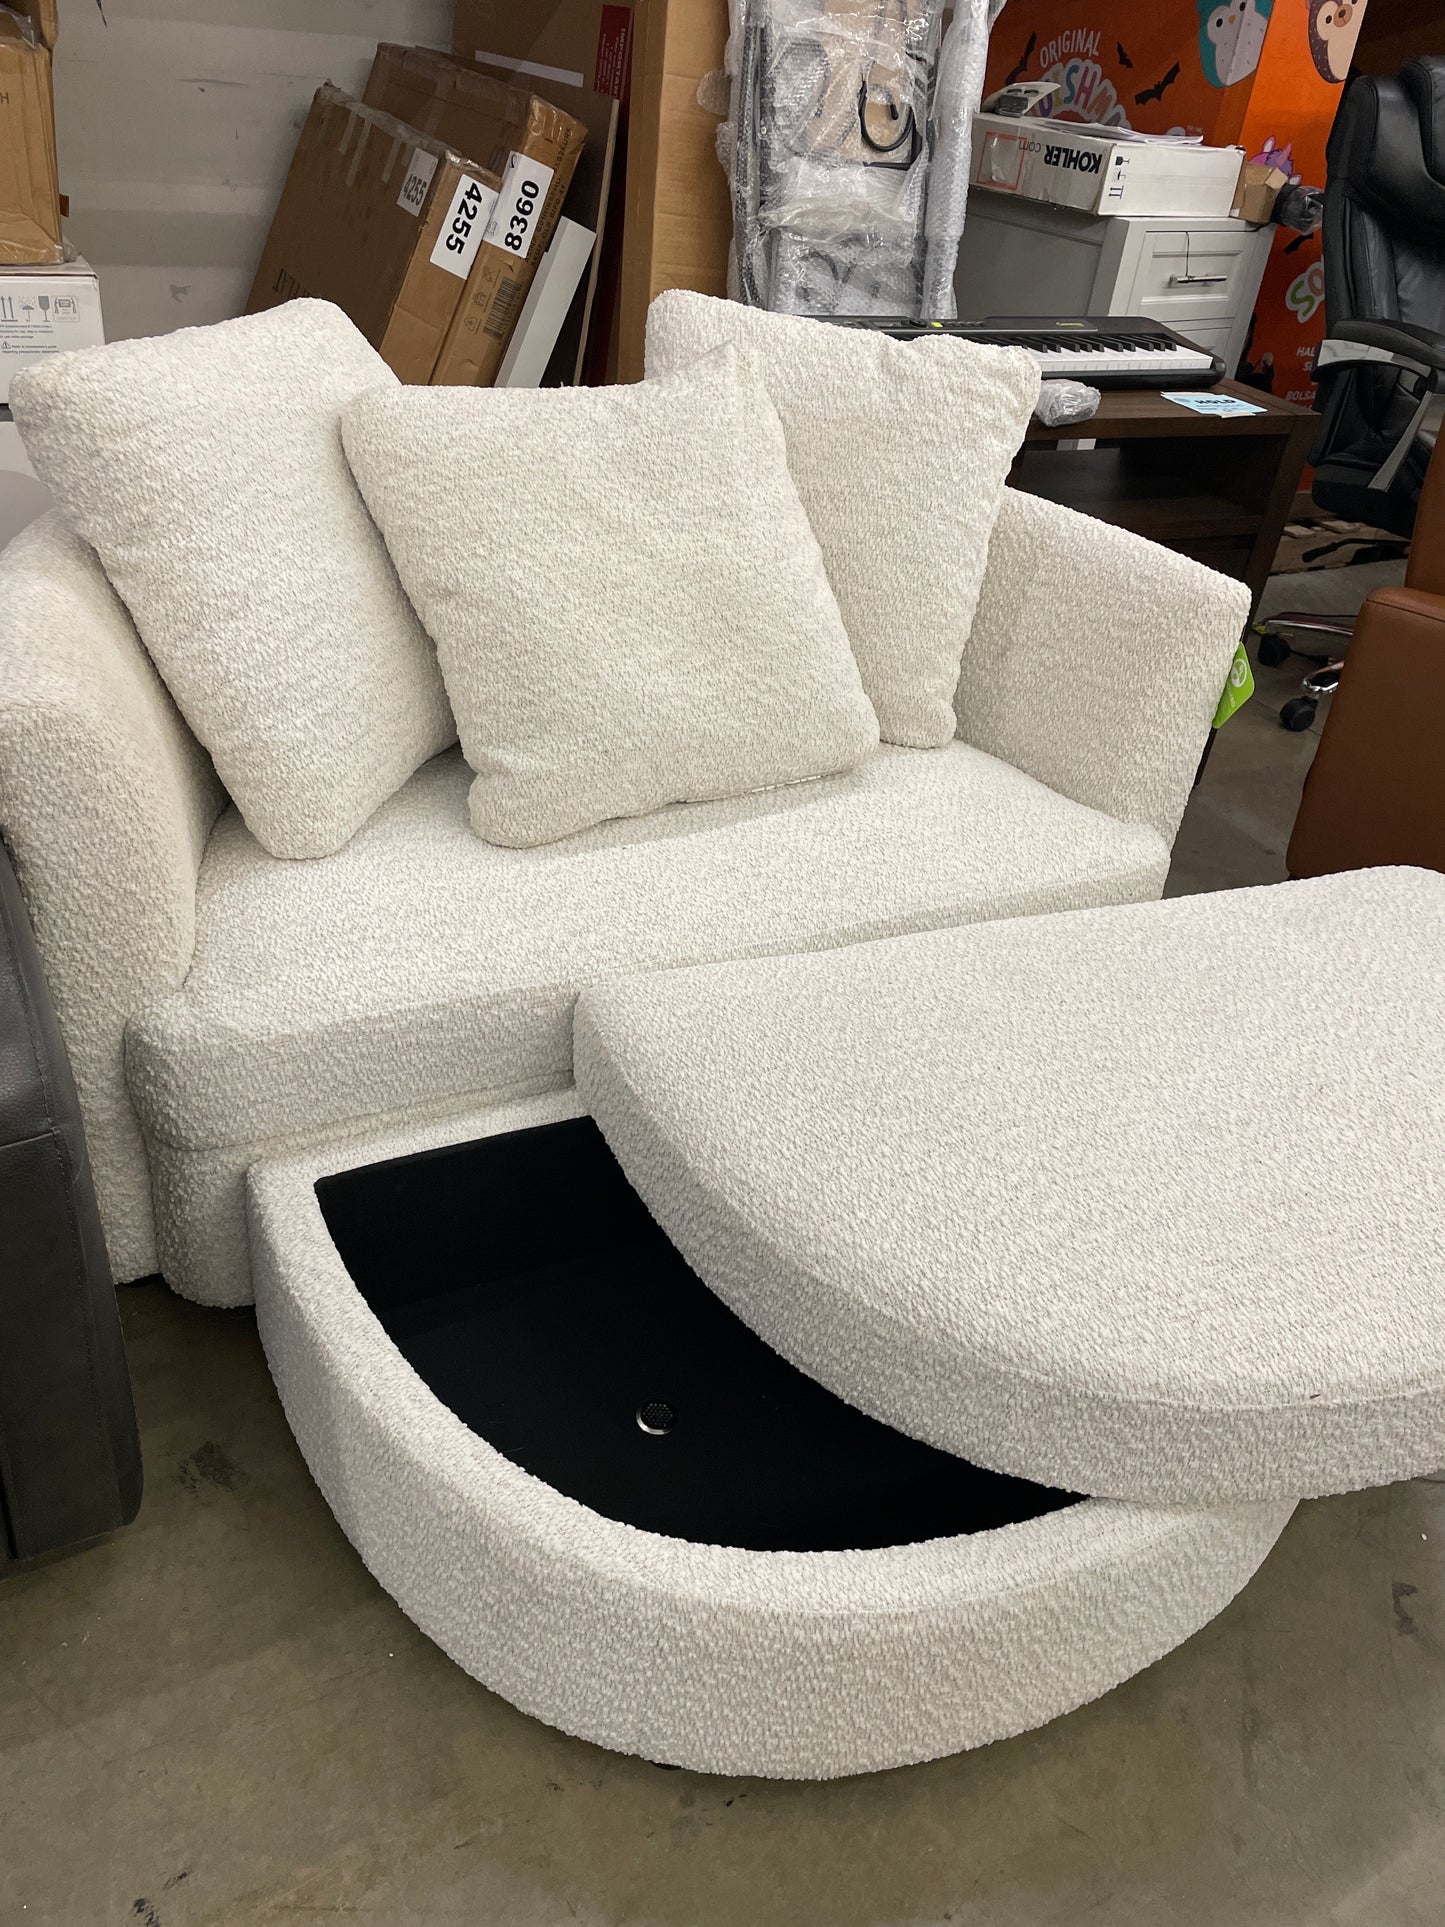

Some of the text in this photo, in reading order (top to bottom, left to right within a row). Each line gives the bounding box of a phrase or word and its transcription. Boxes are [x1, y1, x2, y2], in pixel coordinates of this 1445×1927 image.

[1040, 27, 1101, 68] ORIGINAL
[403, 173, 427, 207] 4255
[446, 182, 483, 254] 4255
[504, 180, 539, 251] 8360
